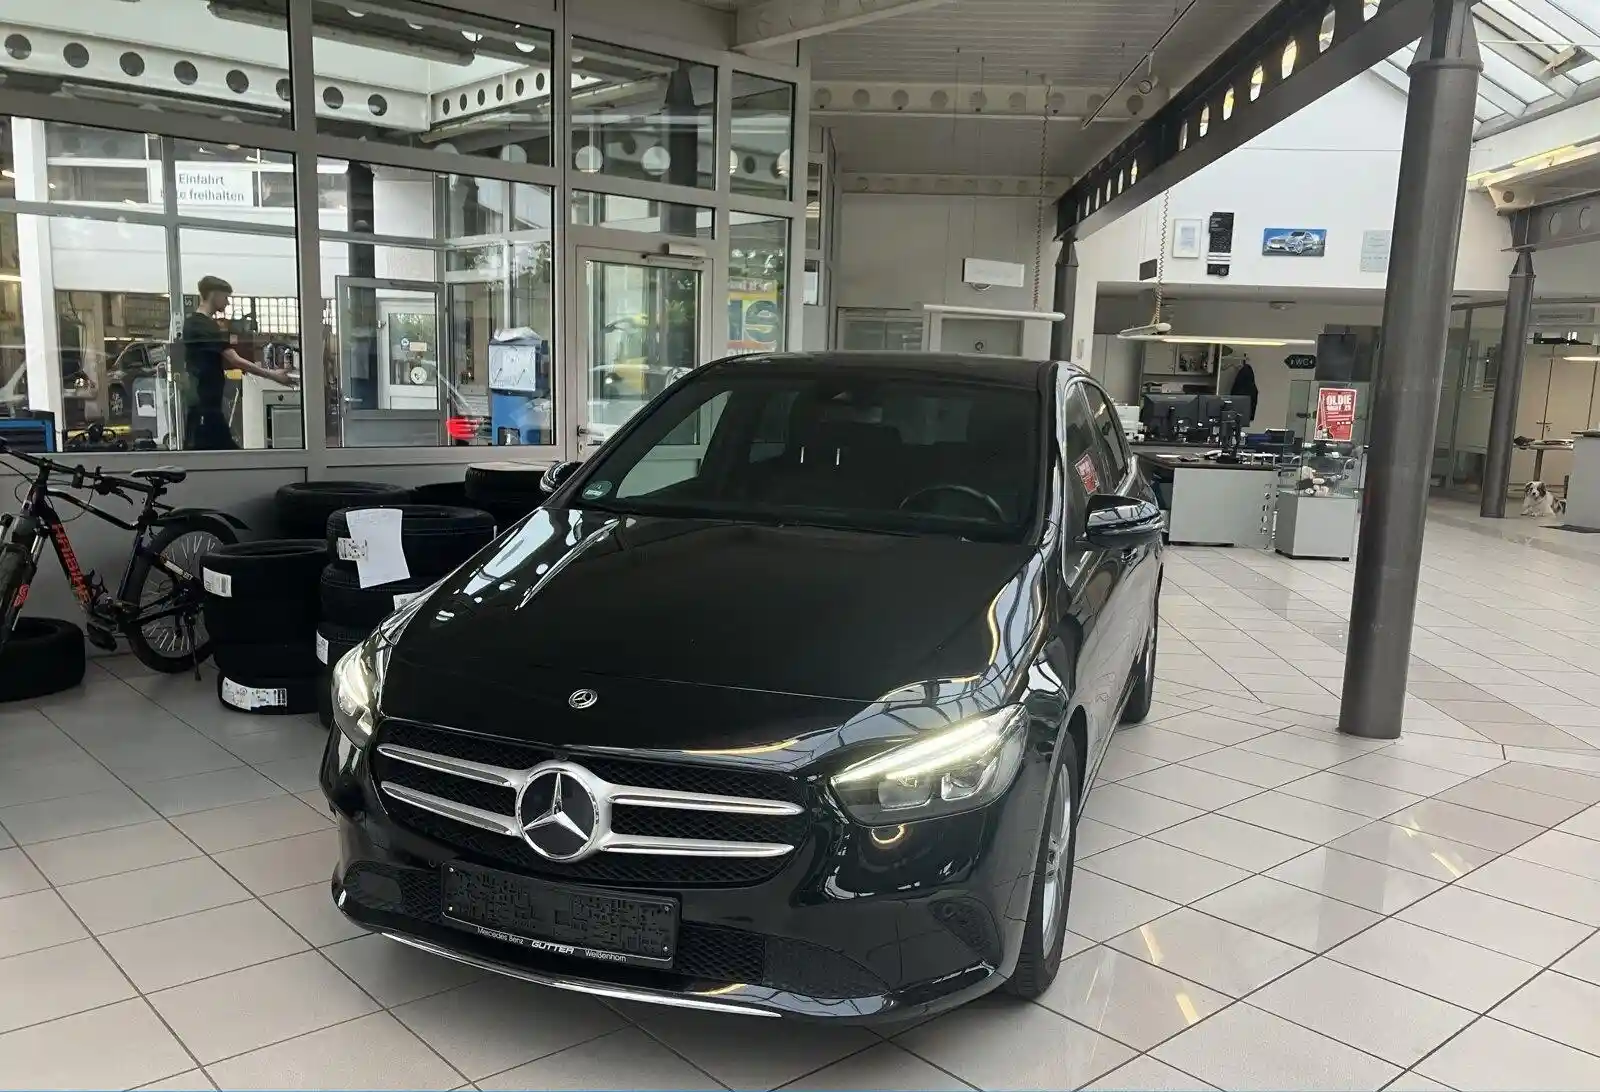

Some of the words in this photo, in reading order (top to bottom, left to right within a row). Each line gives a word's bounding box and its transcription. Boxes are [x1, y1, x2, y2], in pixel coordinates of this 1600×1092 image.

[178, 173, 225, 186] Einfahrt
[189, 188, 245, 201] freihalten
[1295, 358, 1309, 366] WC
[1326, 394, 1352, 406] OLDIE
[477, 925, 508, 941] Mercedes
[508, 934, 524, 945] Benz
[585, 948, 627, 962] Weißenhorn
